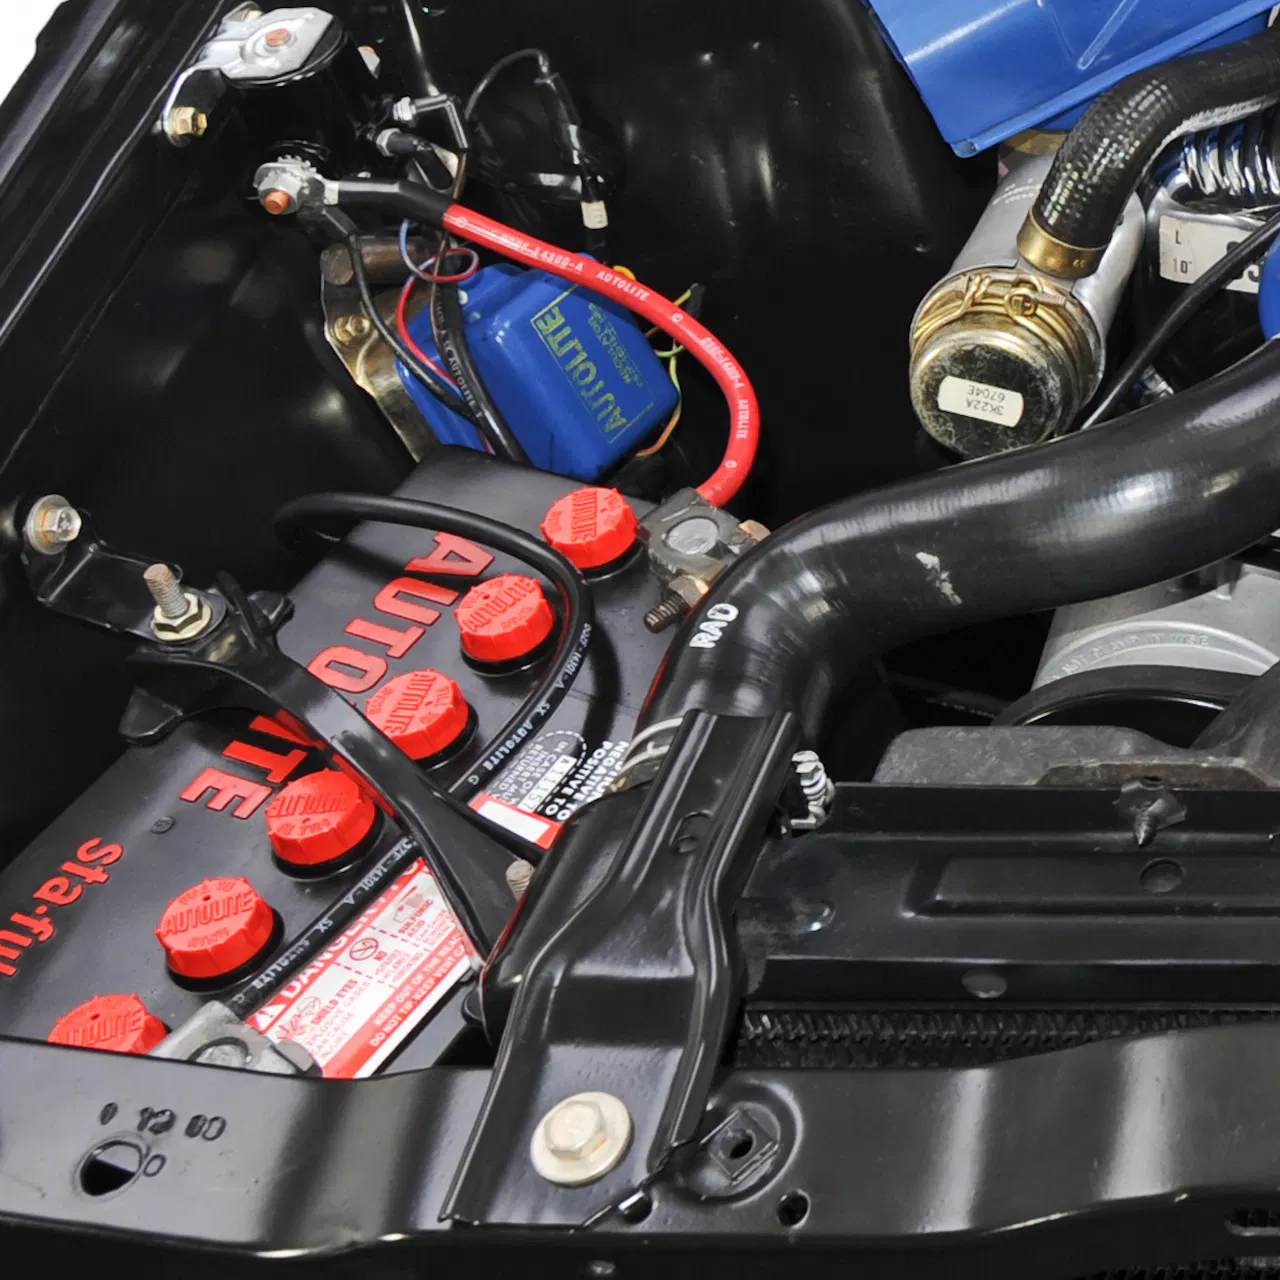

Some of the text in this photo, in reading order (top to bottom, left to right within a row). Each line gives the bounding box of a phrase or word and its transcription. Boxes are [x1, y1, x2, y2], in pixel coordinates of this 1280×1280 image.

[1174, 230, 1183, 246] L
[597, 270, 650, 301] AUTOLITE
[448, 356, 477, 410] AUTOLITE
[536, 305, 628, 434] AUTOLITE
[965, 384, 1006, 403] 6704E
[735, 399, 750, 440] AUTOLITE
[965, 397, 1006, 417] 3K22A
[689, 603, 739, 648] RAD
[180, 531, 495, 819] AUTOITE
[482, 719, 534, 771] AUTOLITE
[499, 743, 544, 791] RETURNED
[531, 753, 558, 779] CASE
[561, 740, 613, 795] POSITIVE
[573, 740, 630, 801] NEGATIVE
[545, 797, 567, 816] TO
[556, 802, 578, 821] TO
[160, 888, 257, 939] AUTOLITE
[251, 939, 311, 990] AUTOLITE
[311, 978, 359, 1026] SHIELD EYES
[368, 1031, 388, 1048] DO
[383, 1014, 403, 1035] NOT
[413, 977, 436, 1002] KEEP
[433, 957, 456, 980] VENT
[372, 1003, 398, 1026] KEEP
[394, 986, 414, 1007] OUT
[411, 972, 425, 987] OF
[423, 954, 442, 974] THE
